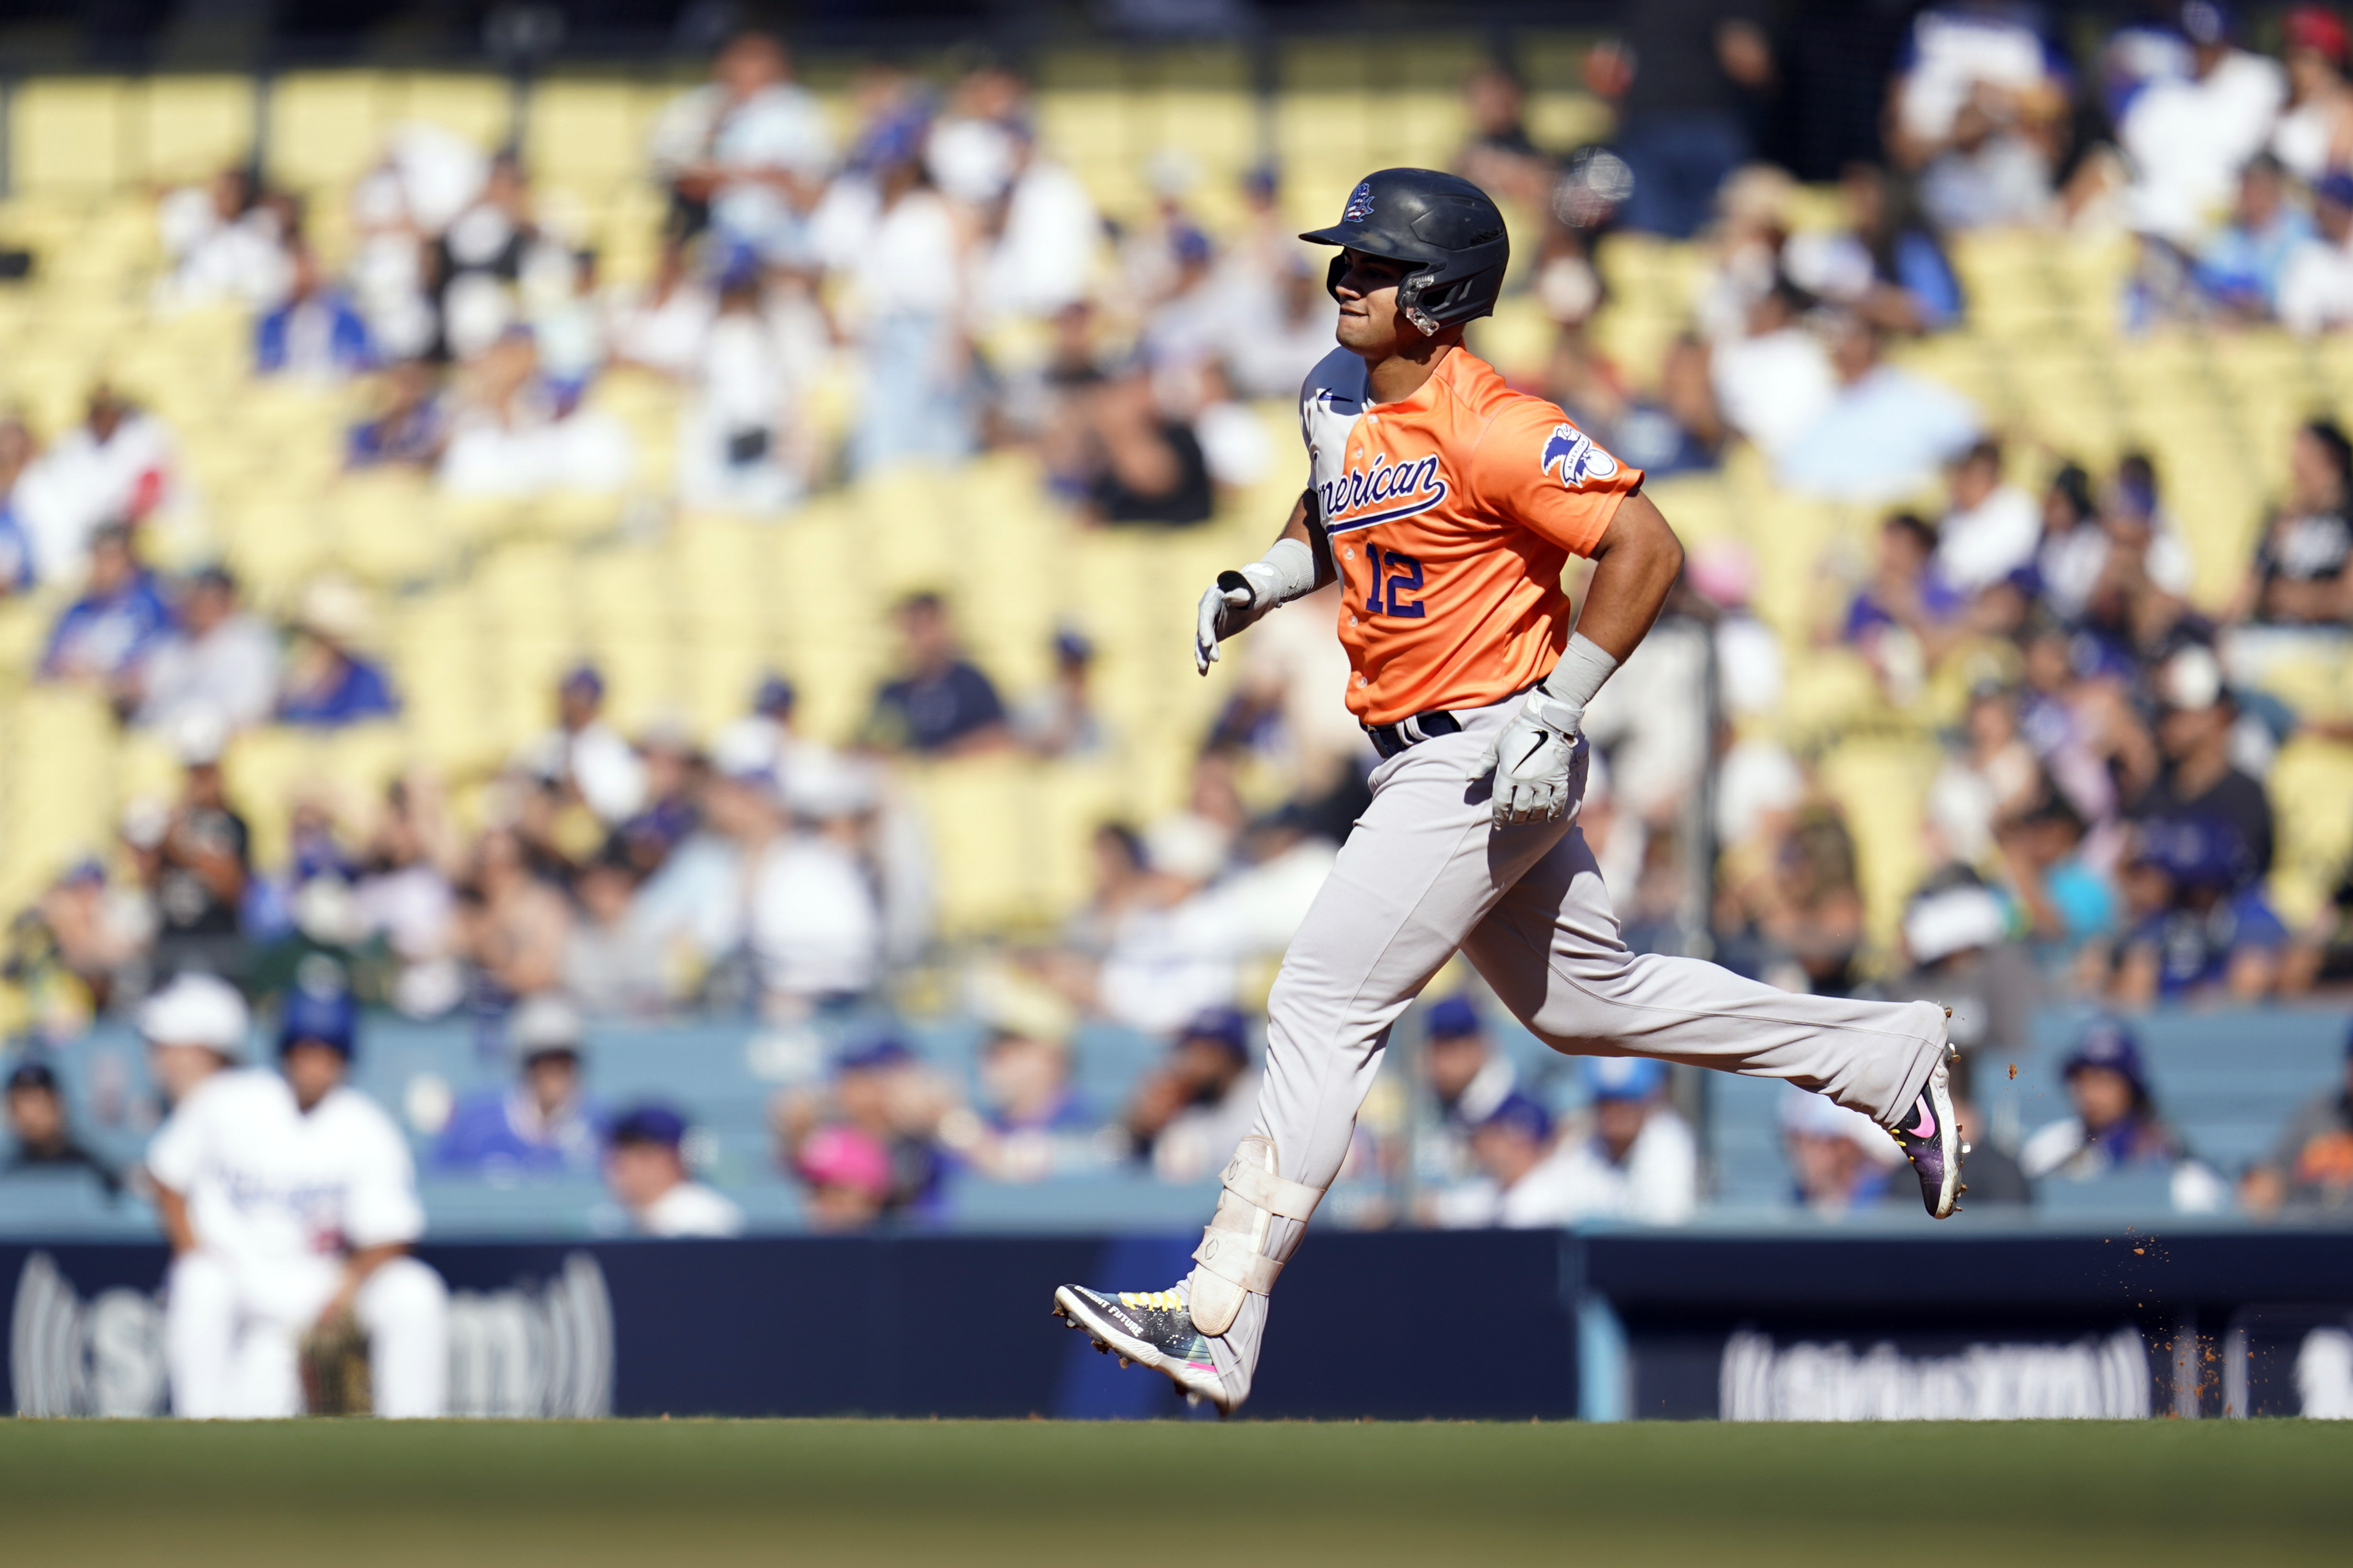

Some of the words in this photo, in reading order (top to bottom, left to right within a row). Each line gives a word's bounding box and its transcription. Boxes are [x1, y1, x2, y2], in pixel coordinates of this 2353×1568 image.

[1314, 452, 1445, 526] merican
[1366, 542, 1426, 618] 12
[1074, 1285, 1111, 1308] BRIGHT
[1108, 1305, 1144, 1337] FUTURE
